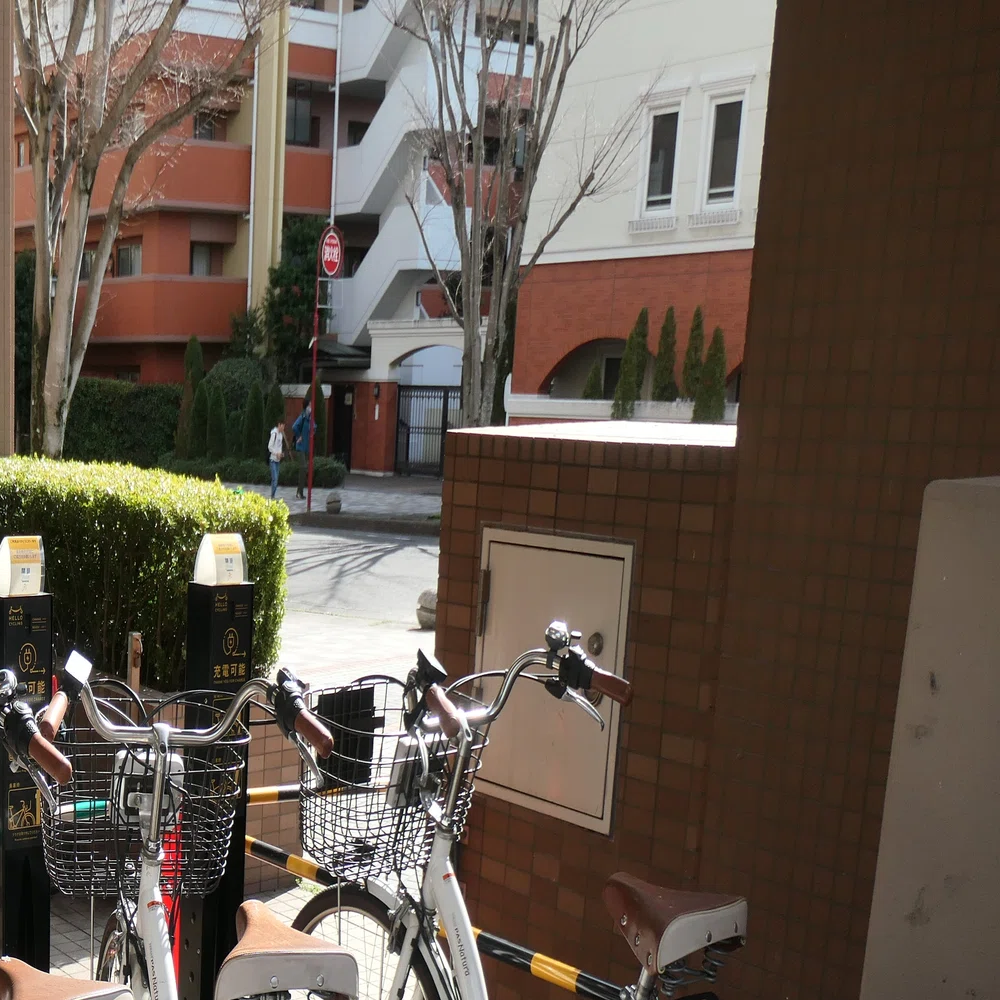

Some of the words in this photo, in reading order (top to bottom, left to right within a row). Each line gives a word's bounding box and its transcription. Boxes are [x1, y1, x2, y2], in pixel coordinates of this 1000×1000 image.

[213, 663, 246, 679] 充電可能
[457, 942, 470, 977] Natura
